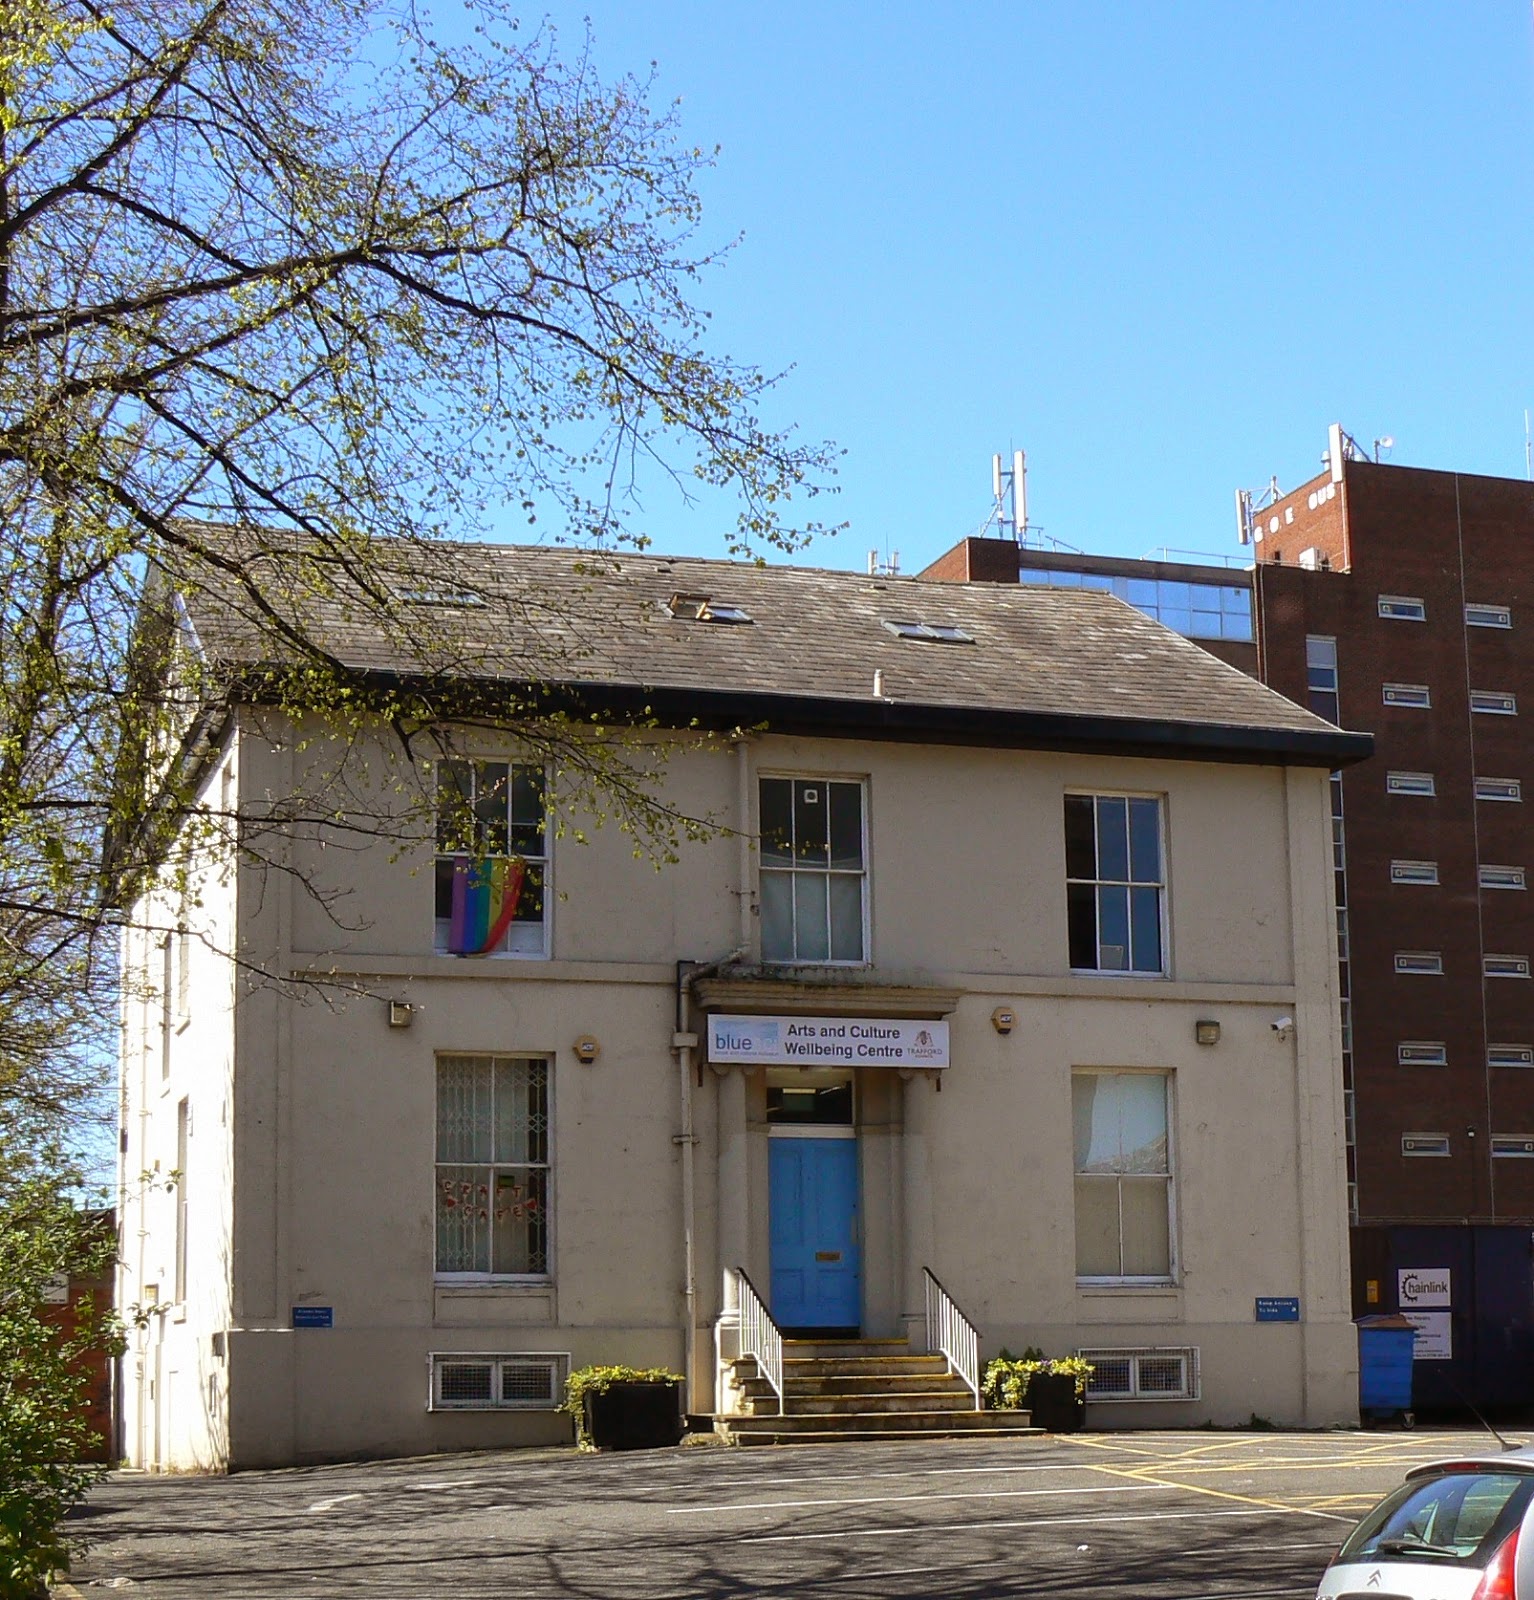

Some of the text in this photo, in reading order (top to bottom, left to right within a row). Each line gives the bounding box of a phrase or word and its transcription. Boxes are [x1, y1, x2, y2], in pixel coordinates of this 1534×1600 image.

[787, 1024, 901, 1039] Arts and Culture
[715, 1033, 753, 1050] blue
[784, 1042, 853, 1059] Wellbeing
[857, 1044, 903, 1057] Centre
[907, 1047, 943, 1055] TRAFFORD
[445, 1181, 521, 1198] CRAFT
[464, 1206, 521, 1219] CAFE
